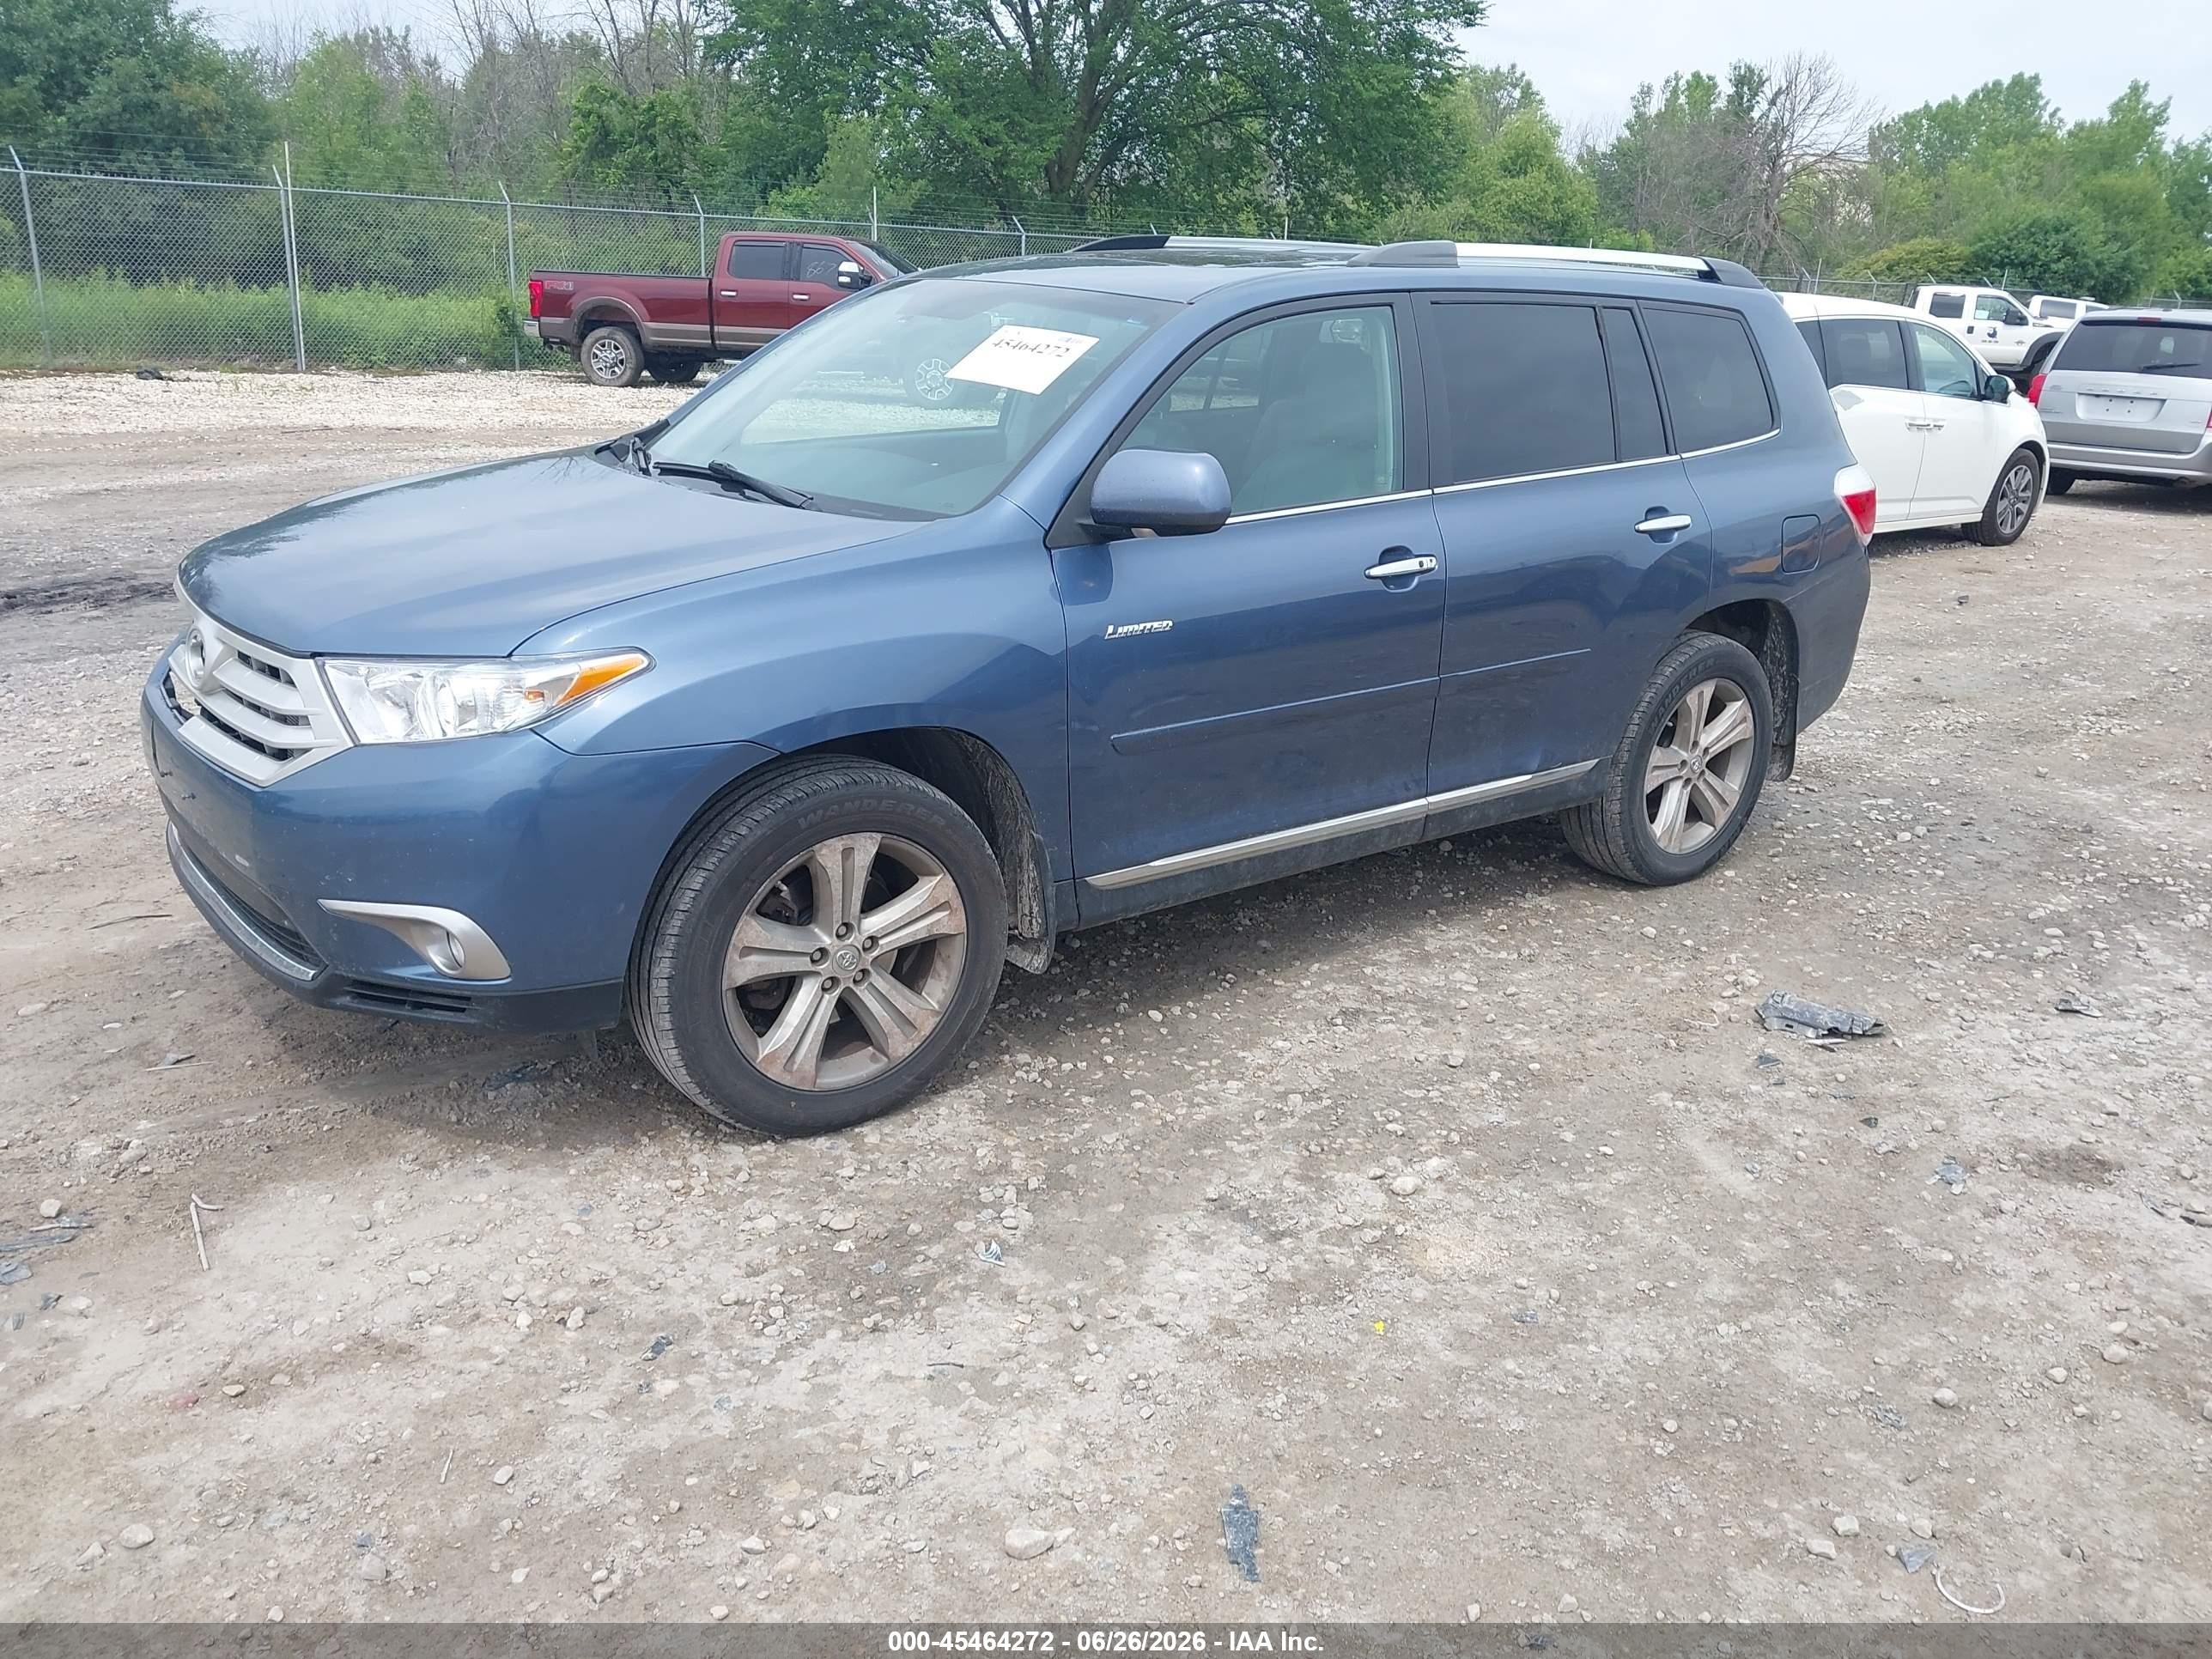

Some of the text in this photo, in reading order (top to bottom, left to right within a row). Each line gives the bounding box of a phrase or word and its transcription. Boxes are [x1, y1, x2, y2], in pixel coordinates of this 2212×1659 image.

[991, 337, 1071, 357] 45464272
[1104, 620, 1174, 640] LIMITED
[797, 798, 946, 830] WANDERER
